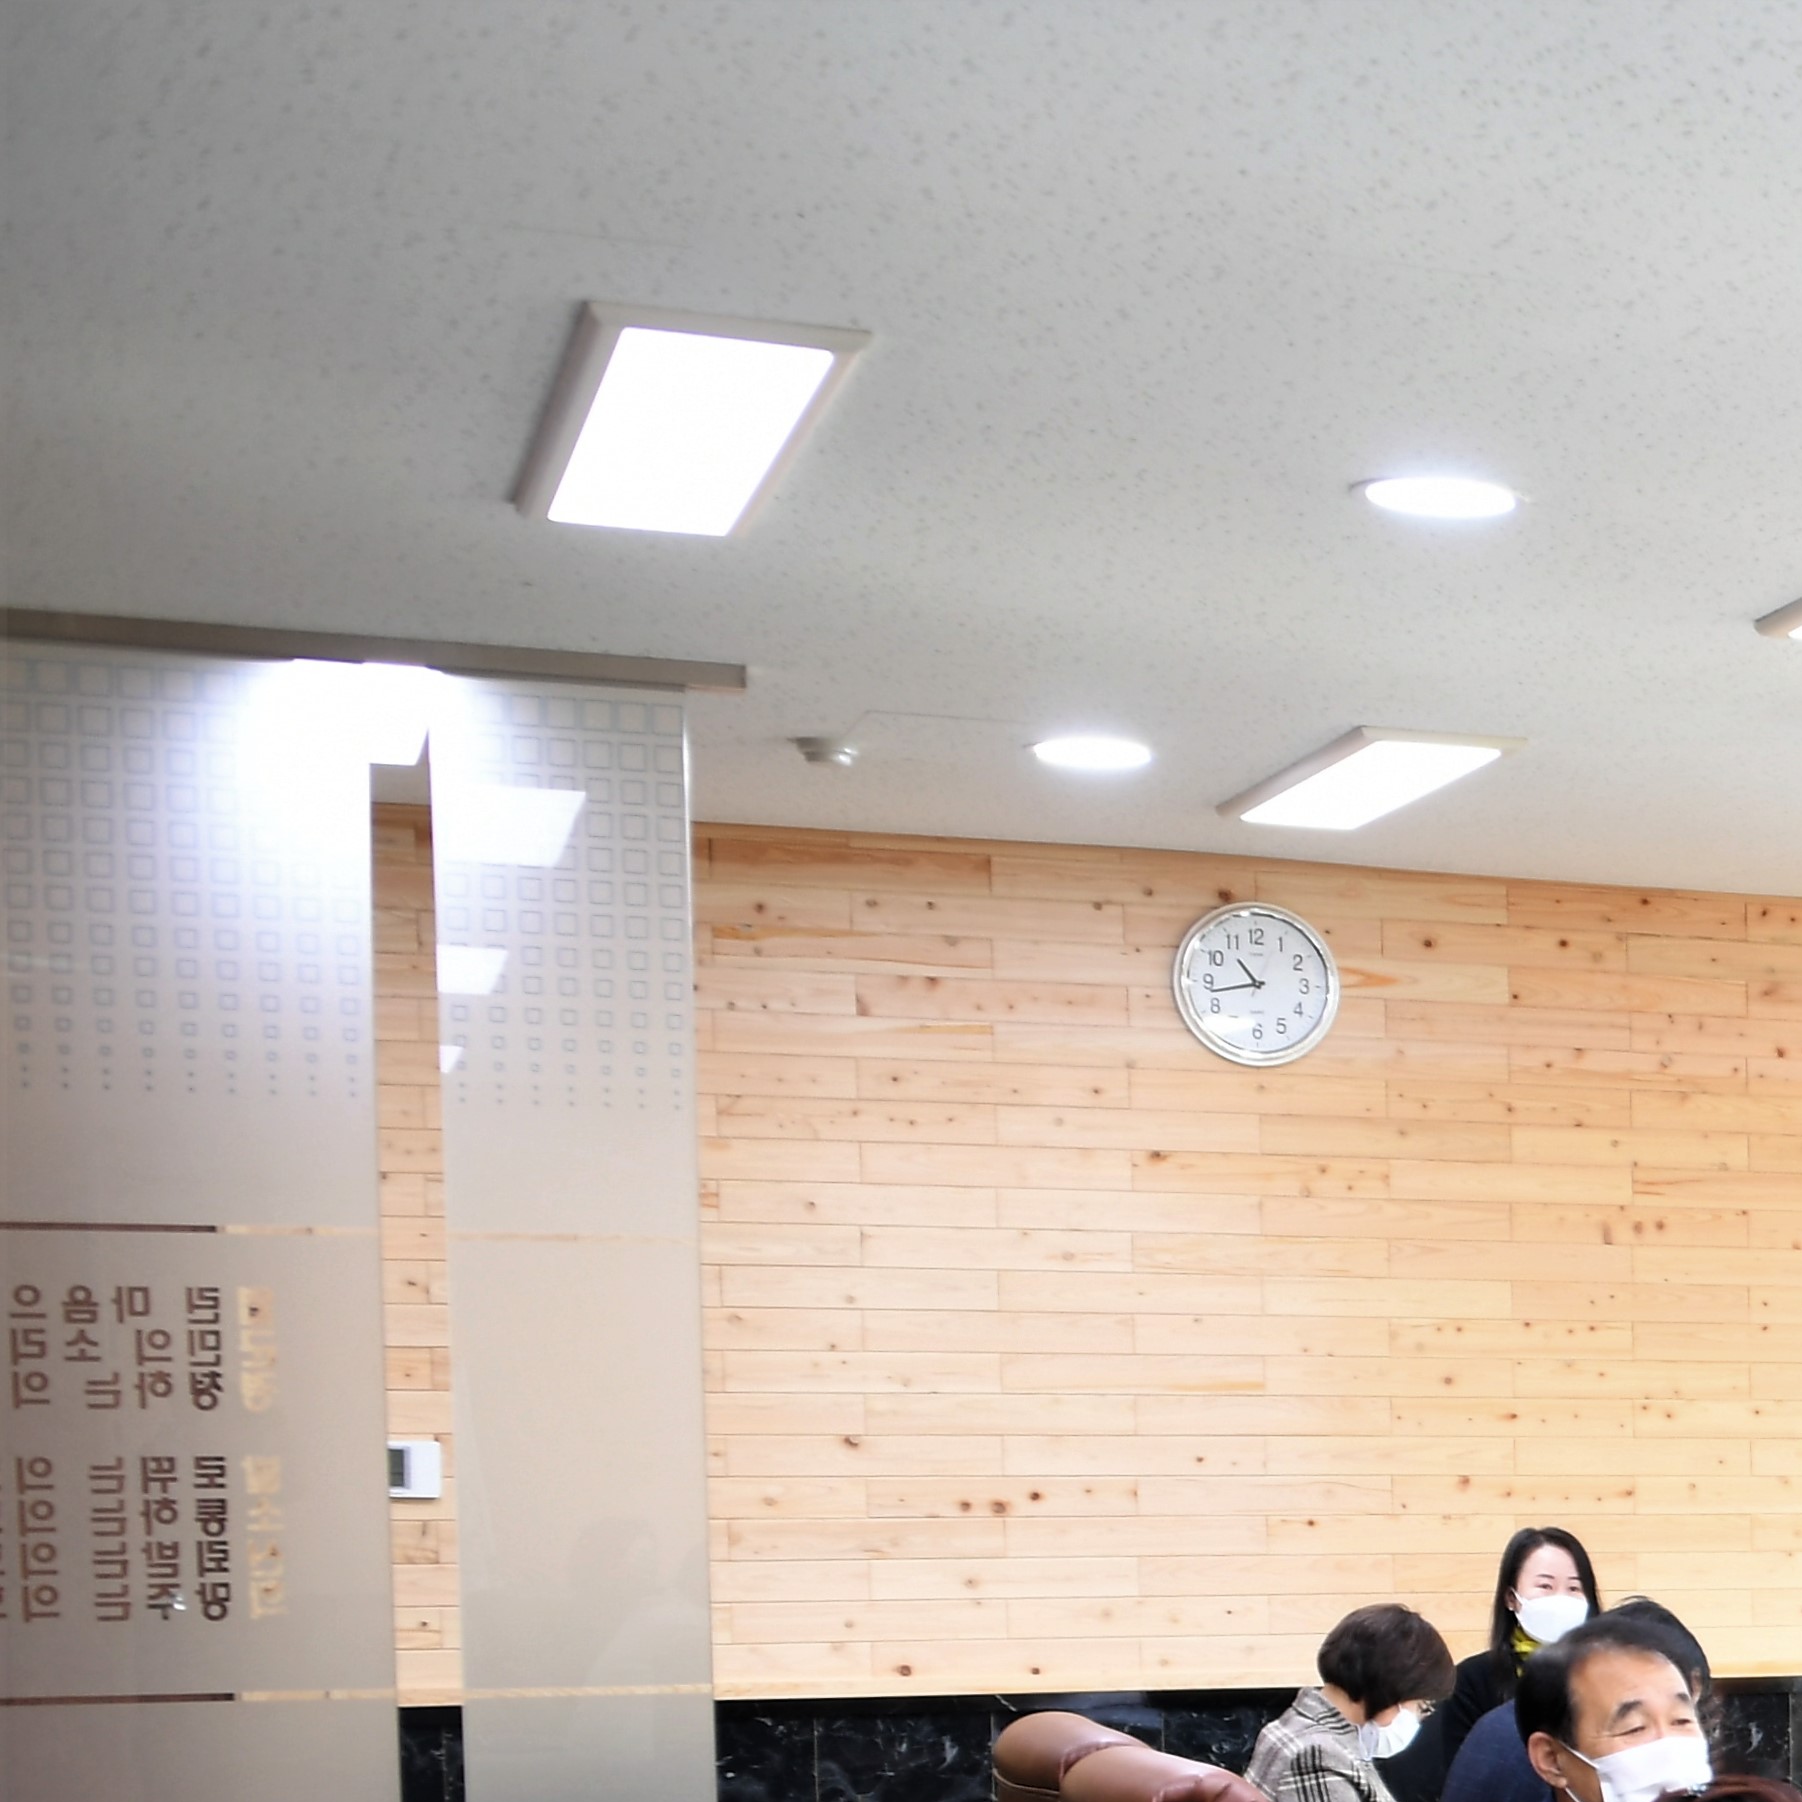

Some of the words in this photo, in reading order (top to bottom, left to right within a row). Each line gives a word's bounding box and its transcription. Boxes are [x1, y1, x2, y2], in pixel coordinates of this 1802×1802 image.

[1227, 934, 1240, 949] 11
[1249, 928, 1264, 945] 12
[1208, 950, 1224, 966] 10
[1293, 954, 1303, 971] 2
[1203, 973, 1214, 990] 9
[1299, 979, 1310, 995] 3
[1210, 998, 1221, 1013] 8
[1293, 1002, 1304, 1016] 4
[1252, 1024, 1263, 1039] 6
[1276, 1018, 1287, 1034] 5
